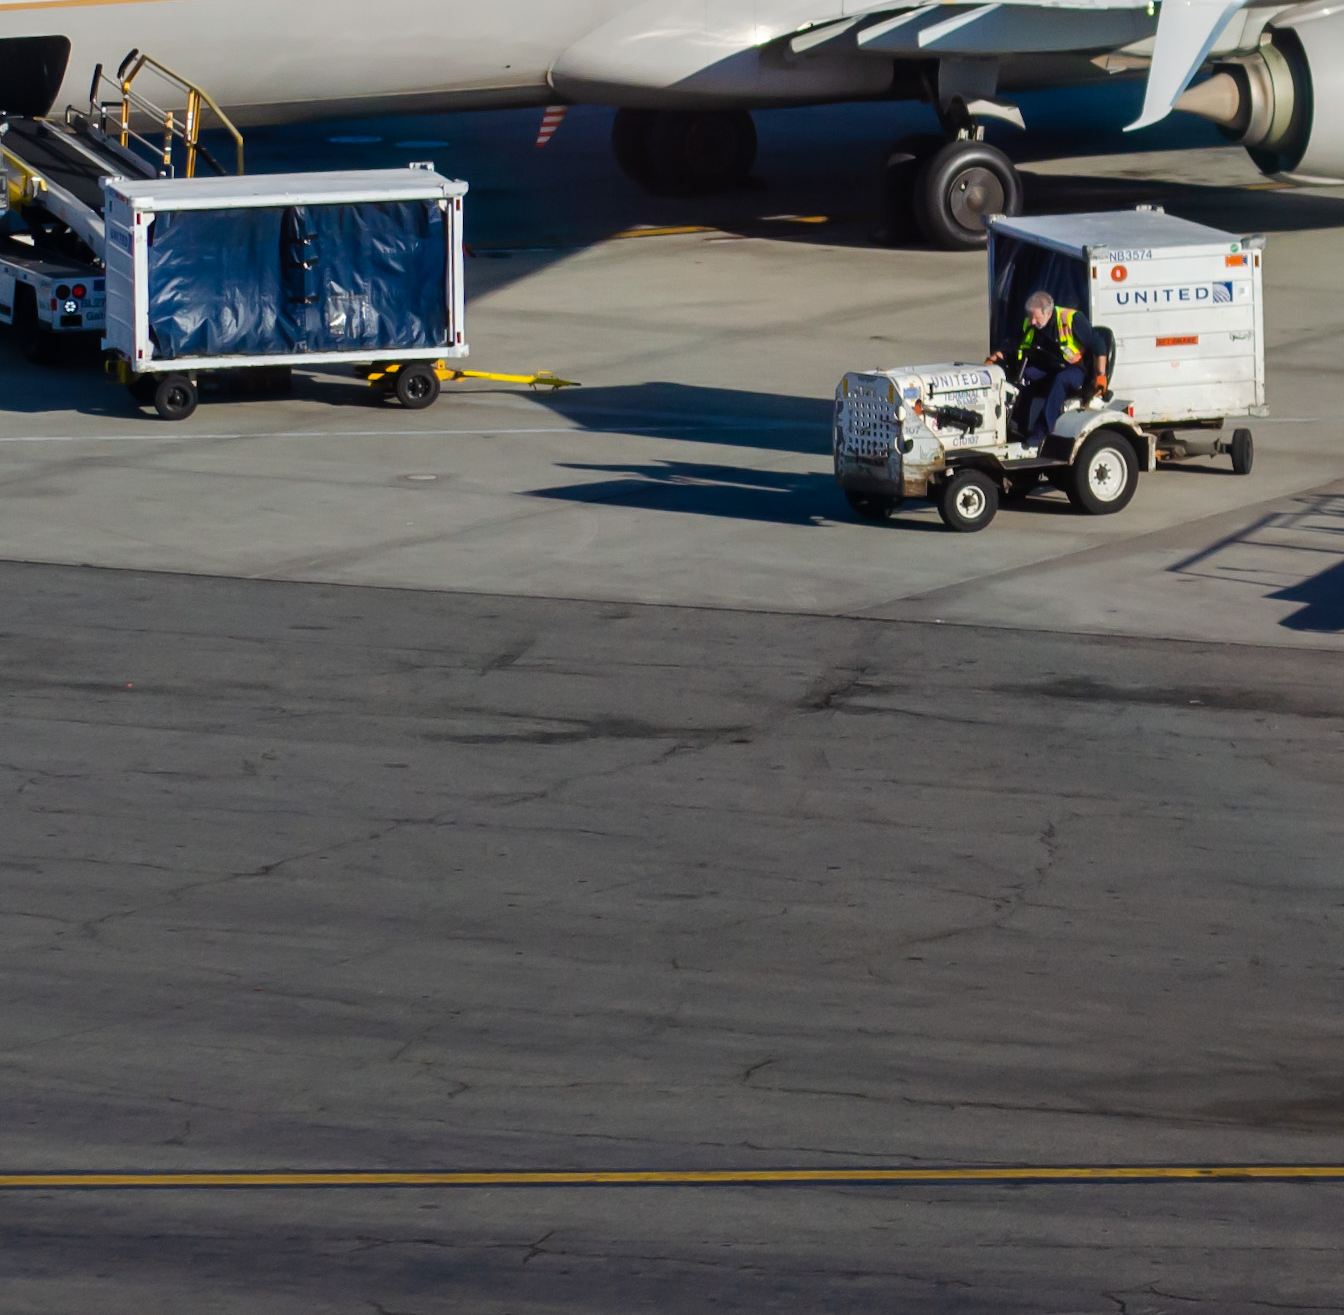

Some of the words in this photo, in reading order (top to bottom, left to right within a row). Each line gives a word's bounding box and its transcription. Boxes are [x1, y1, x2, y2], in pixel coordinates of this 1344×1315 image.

[1109, 250, 1153, 263] NB3574
[1116, 287, 1210, 306] UNITED
[931, 373, 979, 389] UNITED
[944, 390, 979, 401] TERMINAL
[905, 425, 920, 435] 107
